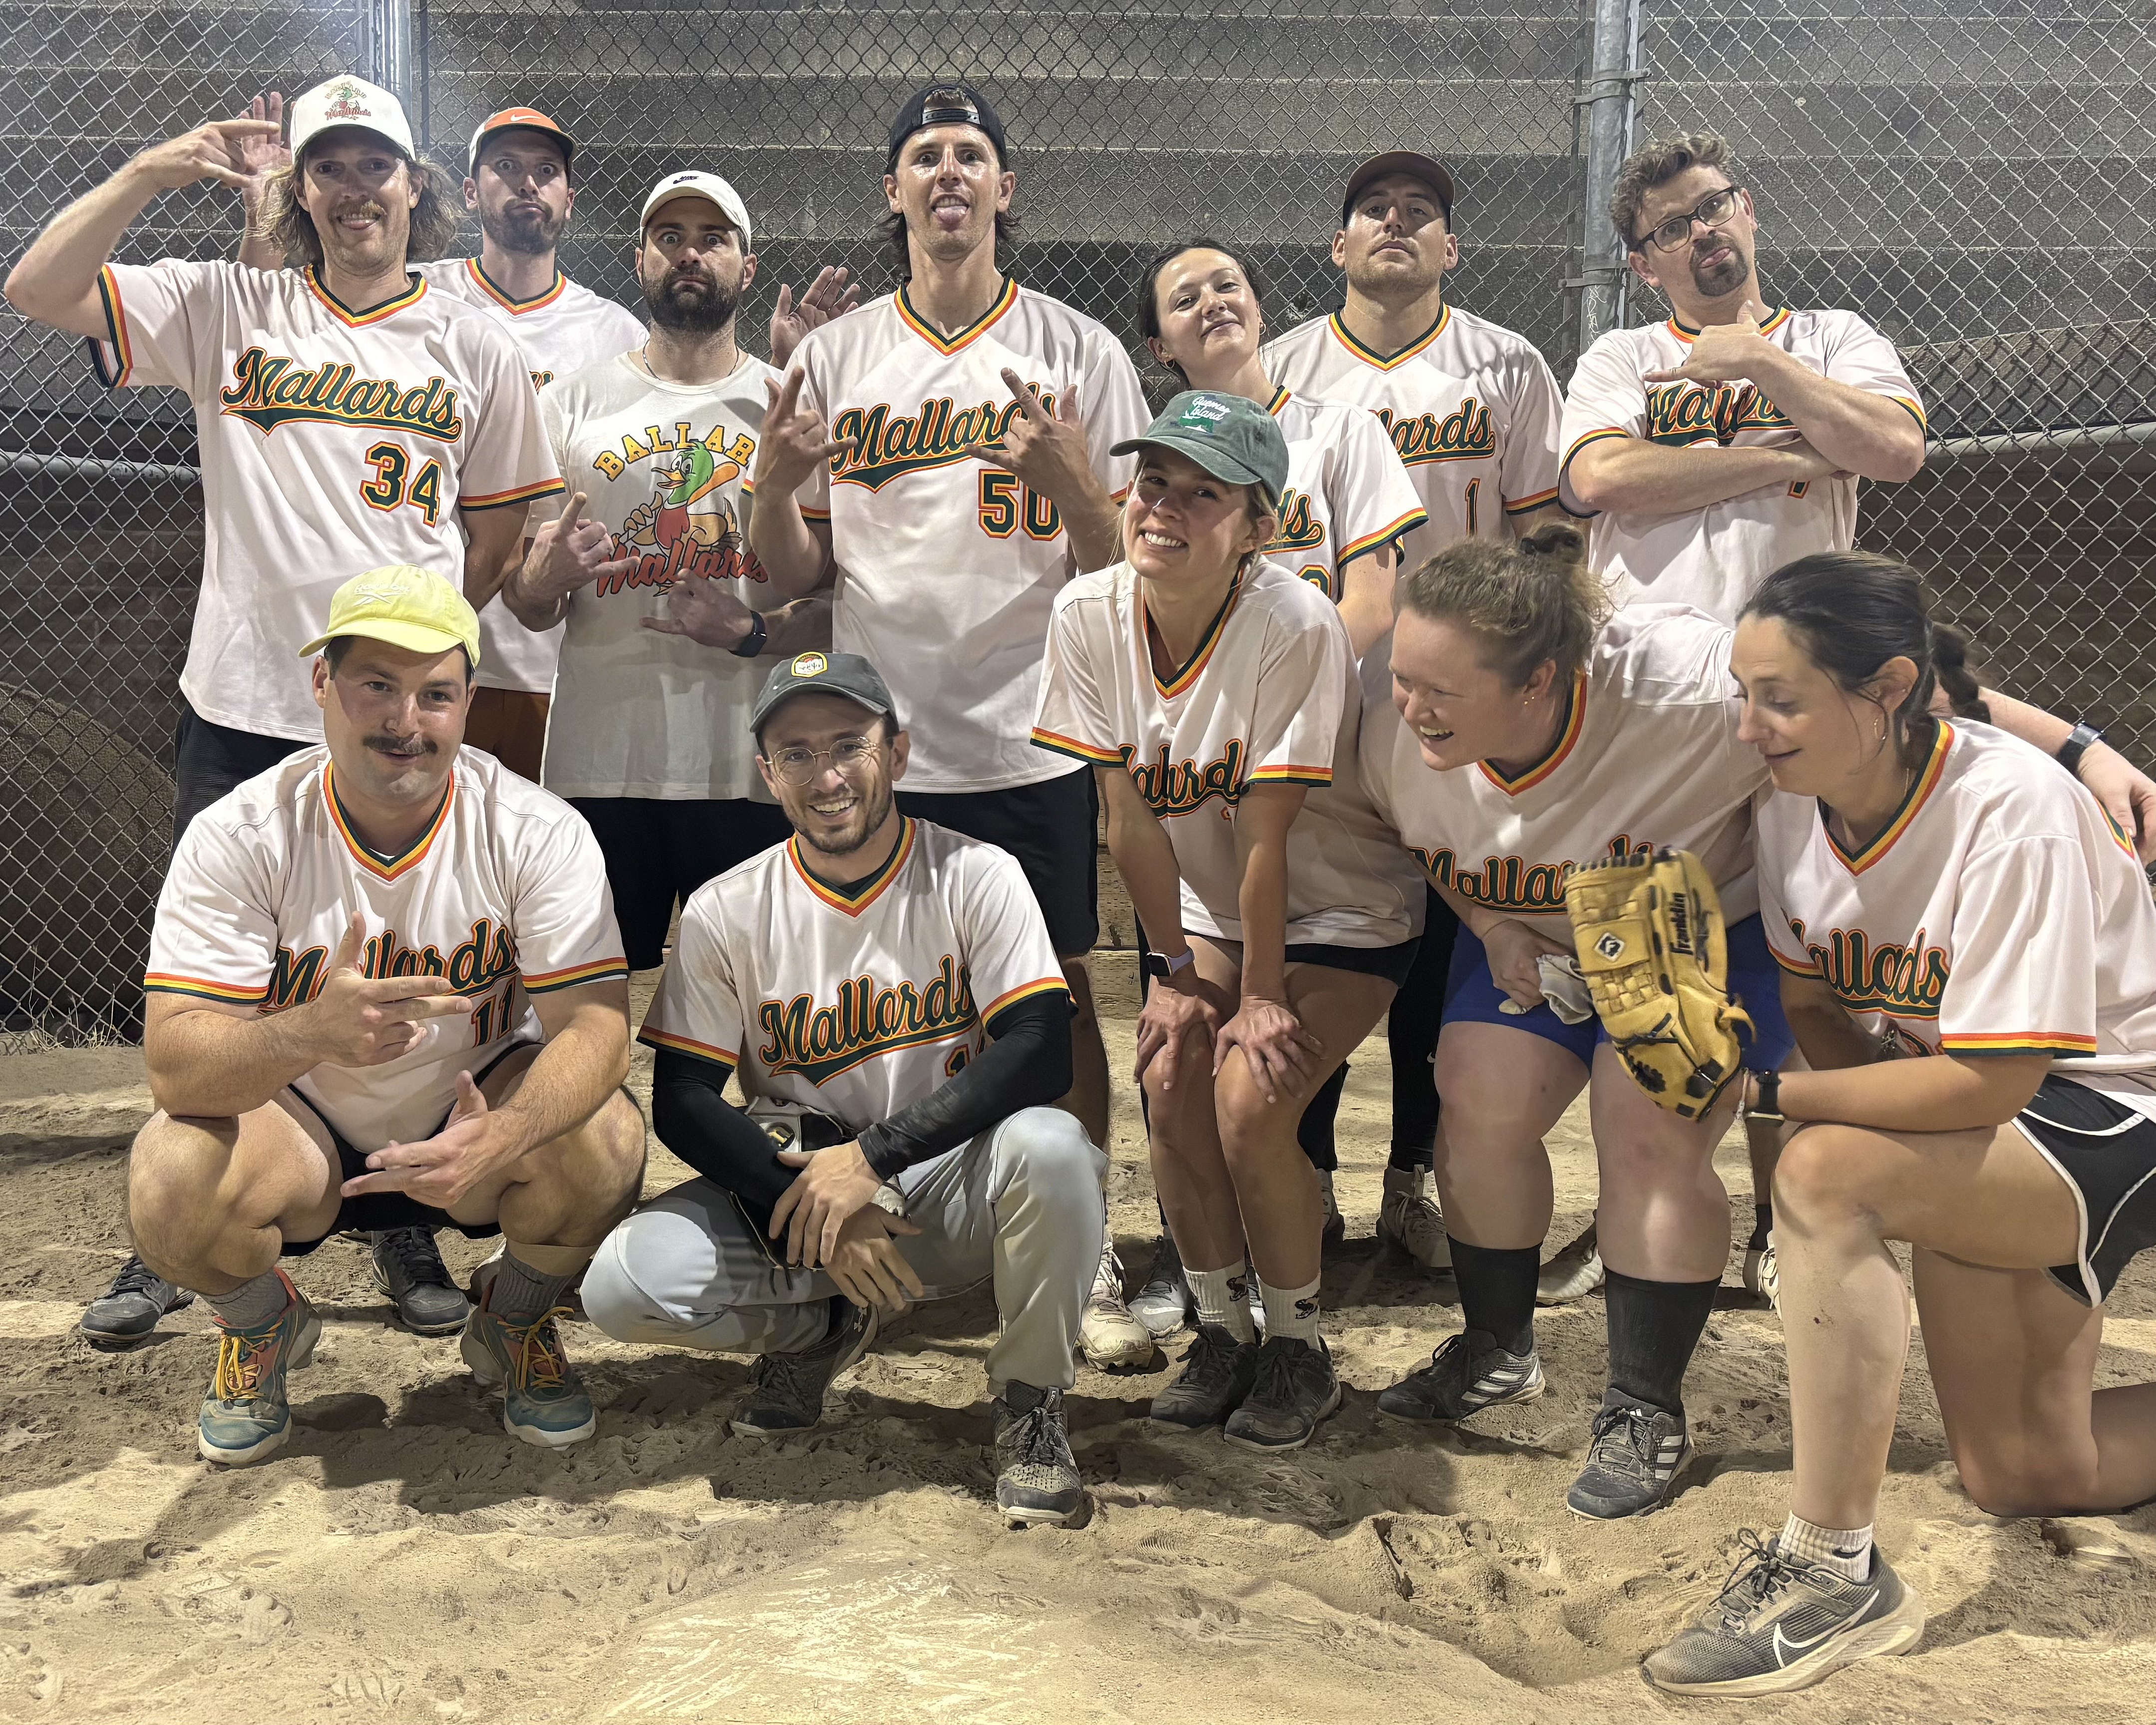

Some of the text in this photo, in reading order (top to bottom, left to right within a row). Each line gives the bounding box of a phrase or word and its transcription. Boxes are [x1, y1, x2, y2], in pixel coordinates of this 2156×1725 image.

[220, 346, 463, 439] Mallards
[1190, 406, 1224, 421] Island
[359, 441, 442, 527] 34
[593, 422, 756, 481] BALLAR
[979, 469, 1063, 541] 50
[267, 917, 520, 1007] Mllards
[471, 979, 516, 1048] 11
[758, 954, 977, 1066] Mallards
